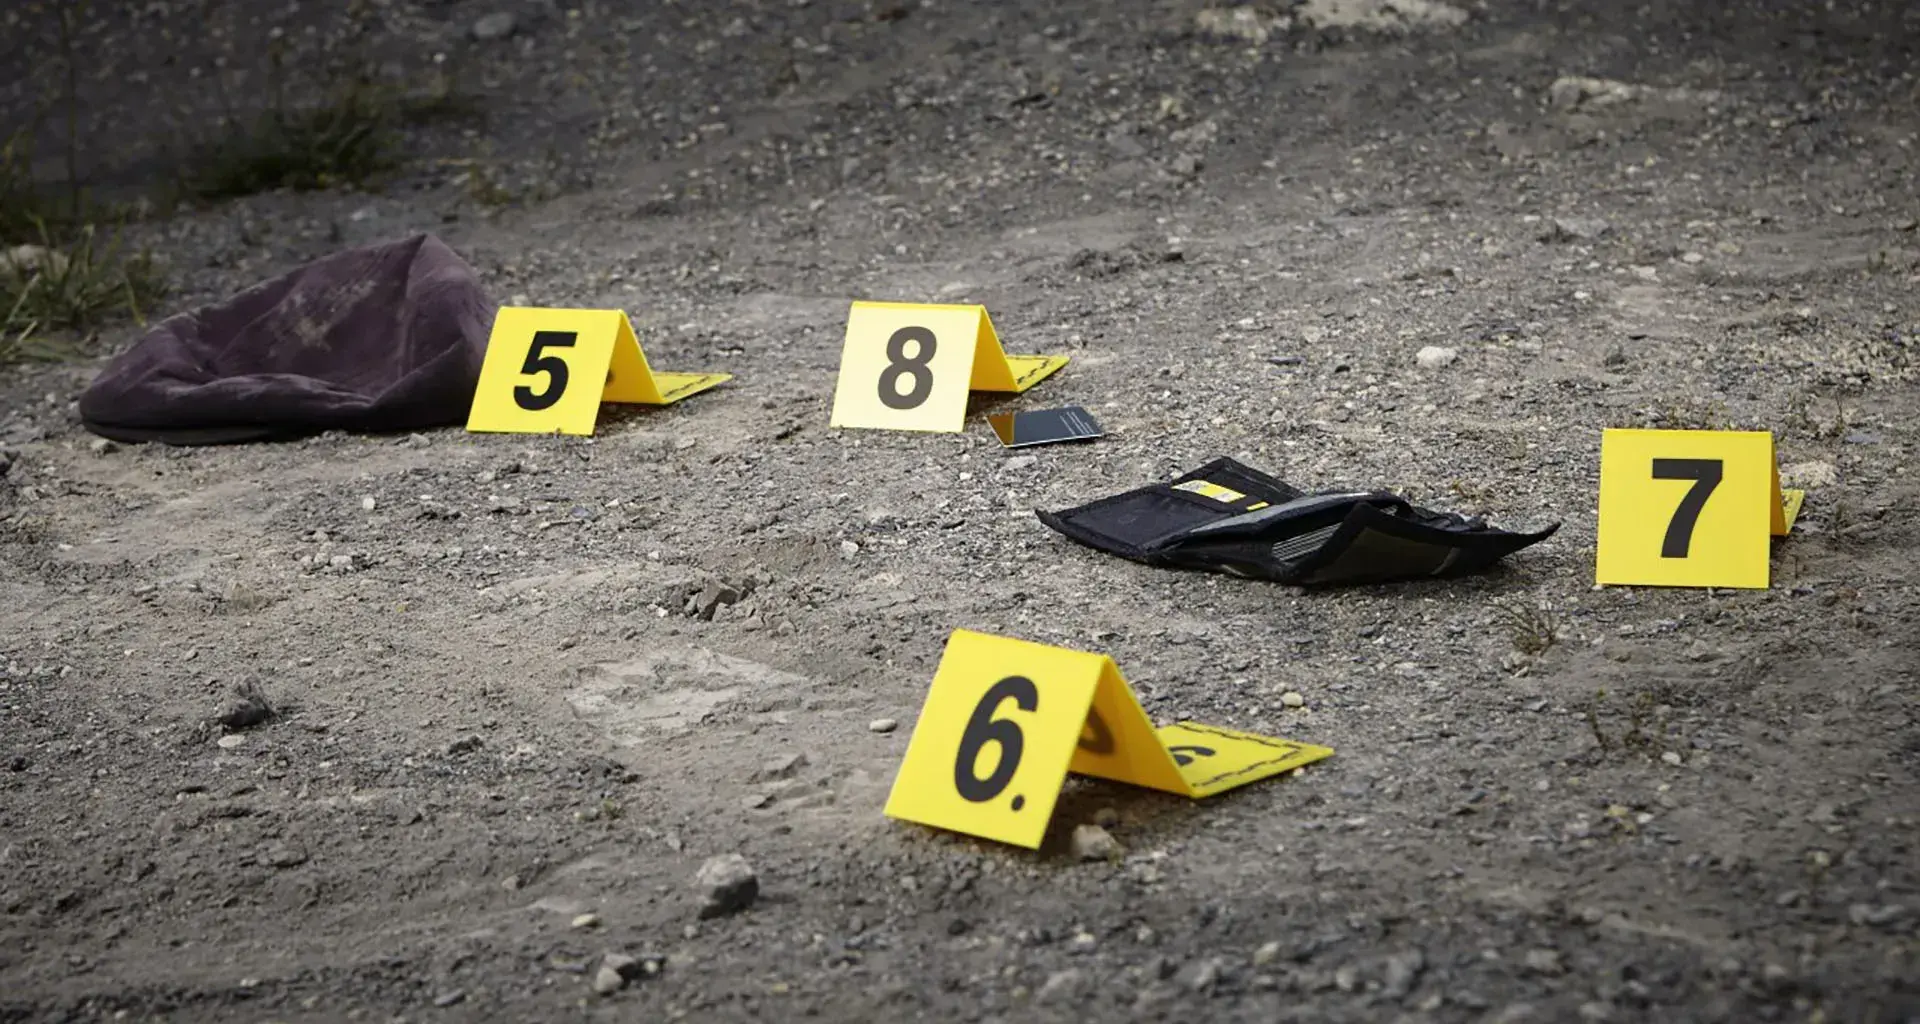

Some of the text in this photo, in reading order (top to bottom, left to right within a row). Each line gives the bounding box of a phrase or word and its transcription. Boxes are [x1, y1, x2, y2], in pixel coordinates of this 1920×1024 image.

[513, 330, 578, 411] 5
[877, 326, 938, 410] 8
[1651, 458, 1724, 558] 7
